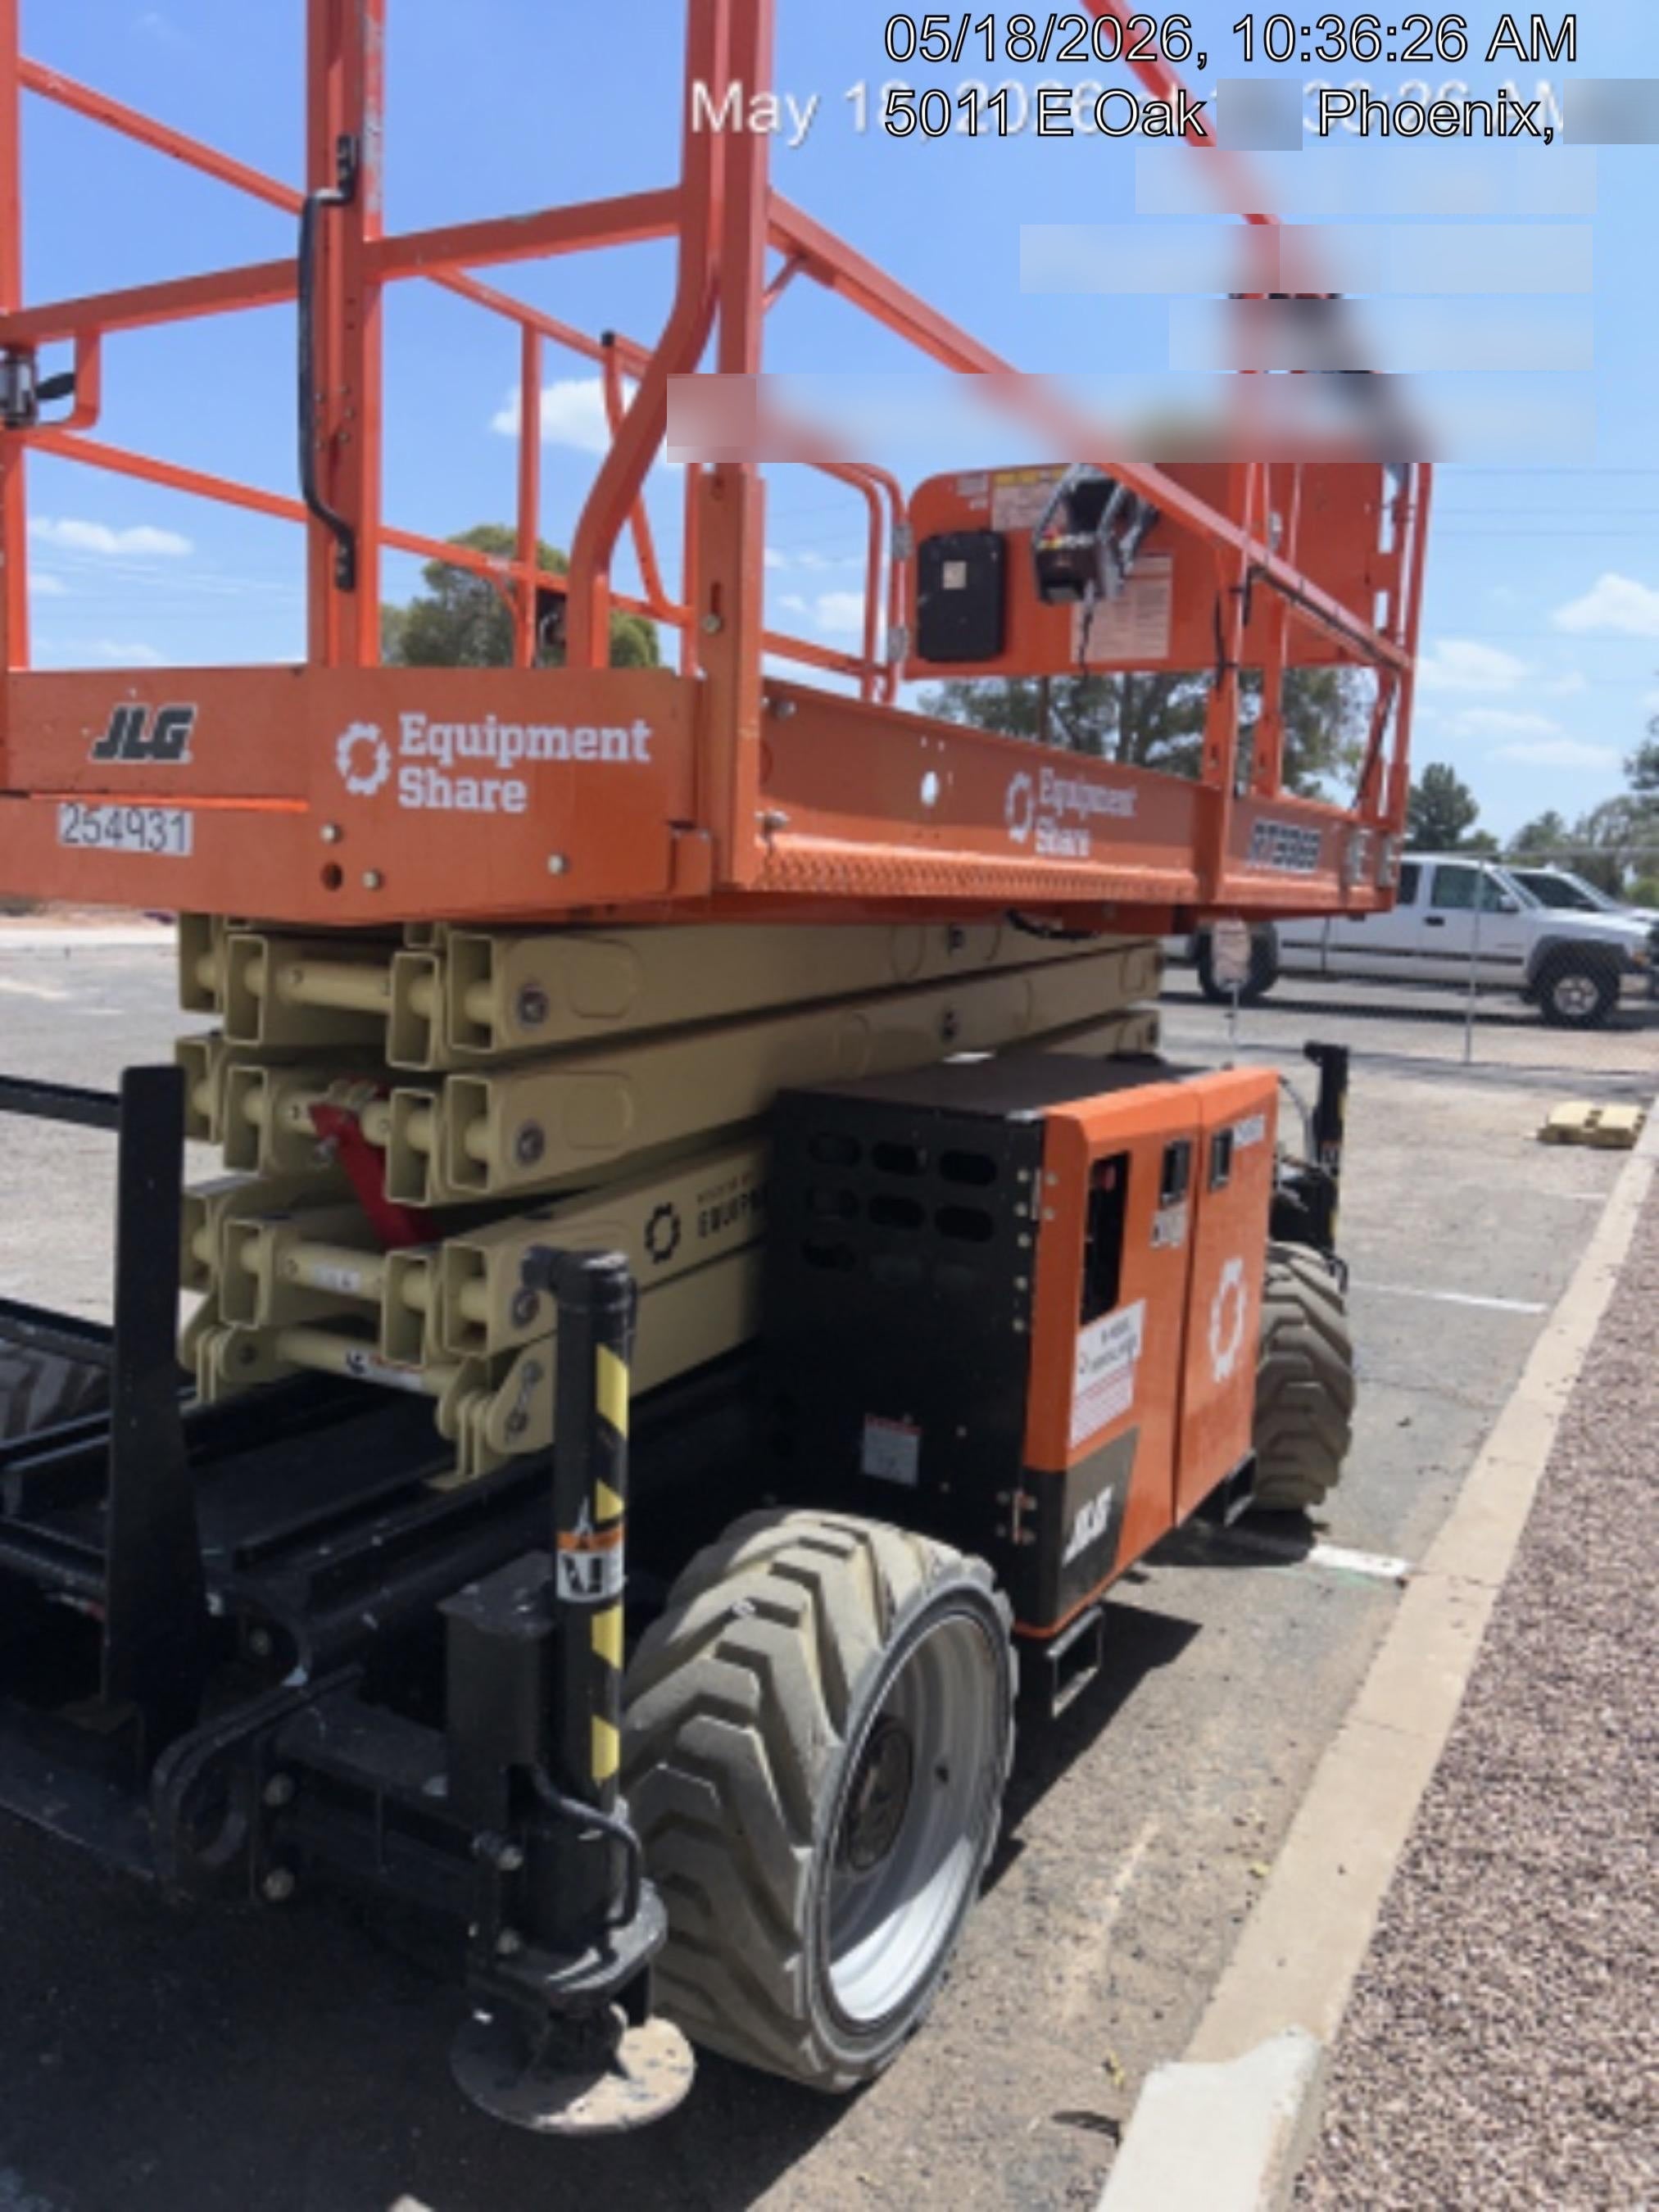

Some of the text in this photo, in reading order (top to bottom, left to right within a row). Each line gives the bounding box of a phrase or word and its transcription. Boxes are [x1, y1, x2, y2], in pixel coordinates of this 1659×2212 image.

[88, 702, 197, 764] JLG
[398, 712, 652, 769] Equipment
[397, 765, 528, 814] Share
[61, 803, 186, 852] 254931
